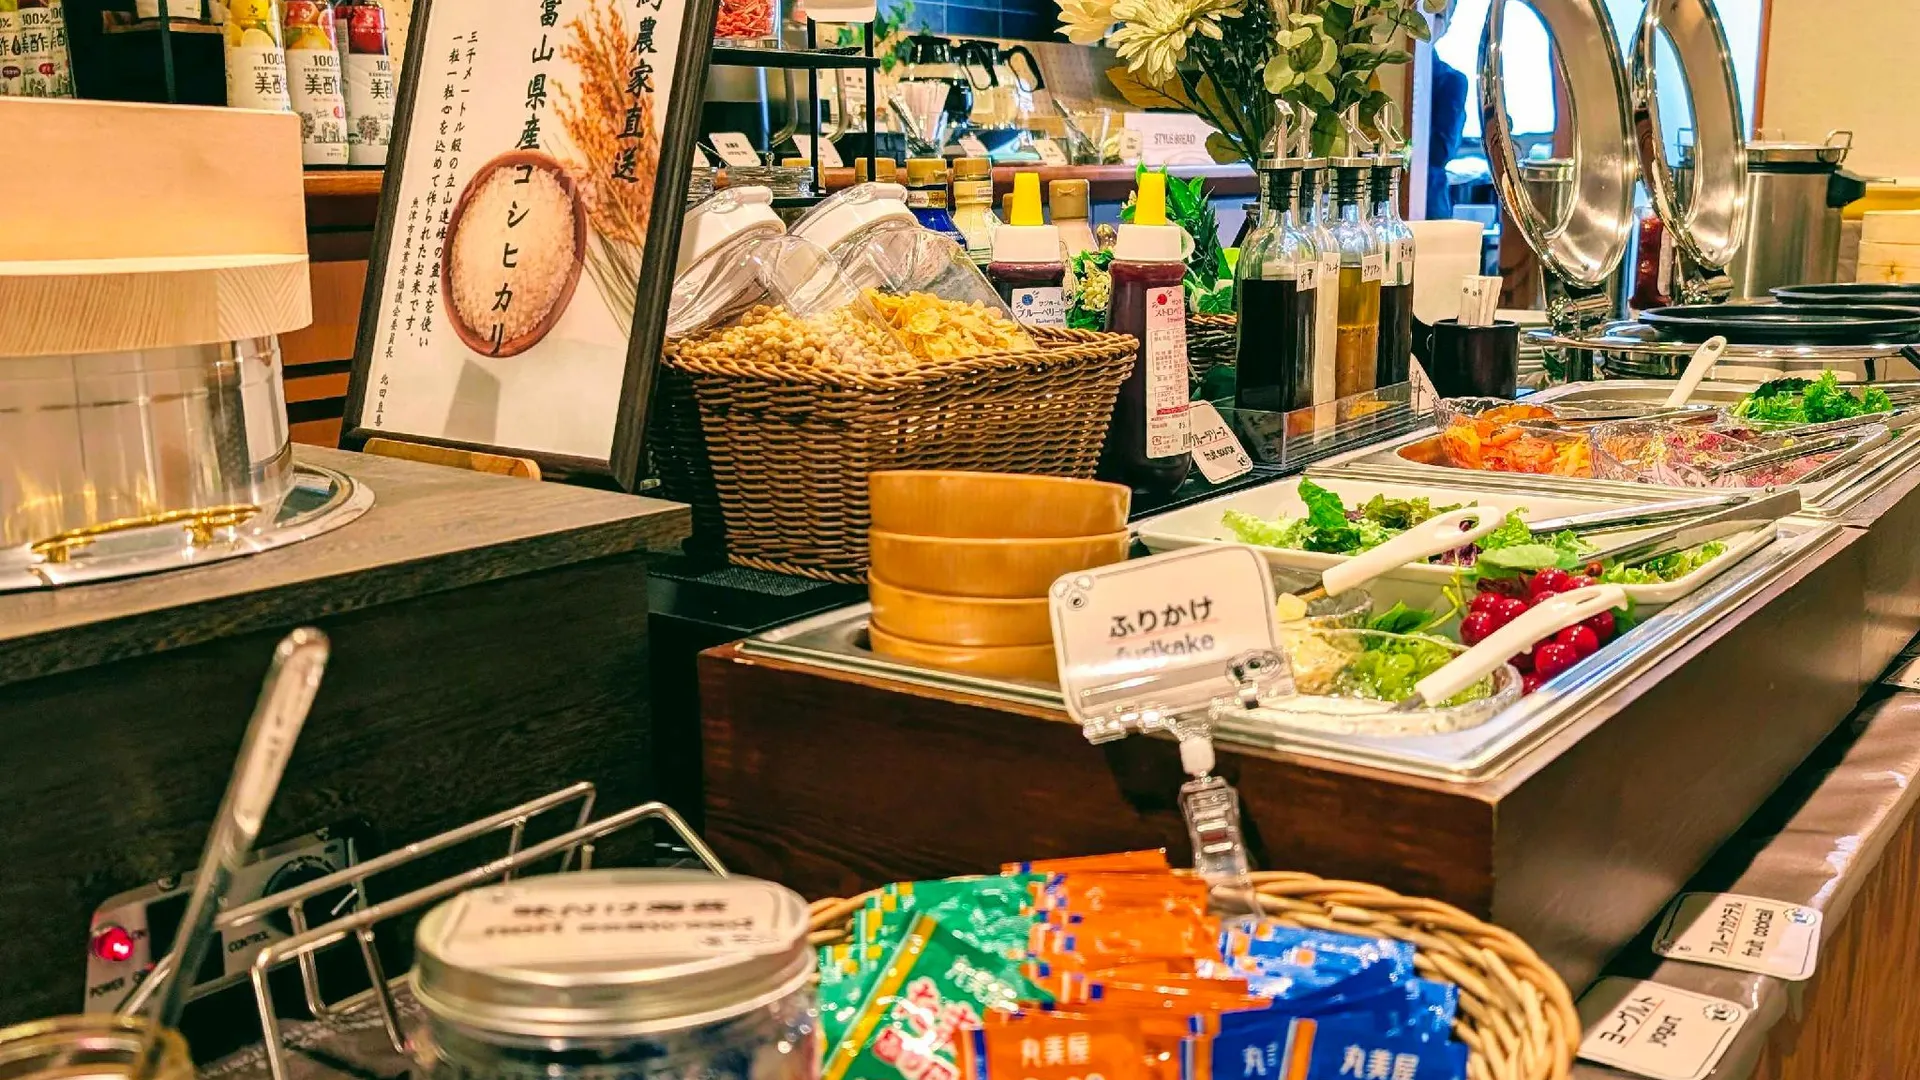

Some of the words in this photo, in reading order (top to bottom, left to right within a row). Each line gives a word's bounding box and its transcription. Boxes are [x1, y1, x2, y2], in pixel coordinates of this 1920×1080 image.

[22, 13, 50, 25] 100%
[1109, 596, 1213, 638] ふりかけ
[1709, 902, 1743, 954] フルーツカクテル
[1741, 940, 1764, 958] fruit
[1755, 908, 1775, 938] cocktail
[1600, 996, 1656, 1045] ヨーグルト
[1021, 1032, 1091, 1068] 丸美屋
[1339, 1044, 1420, 1080] 丸美屋
